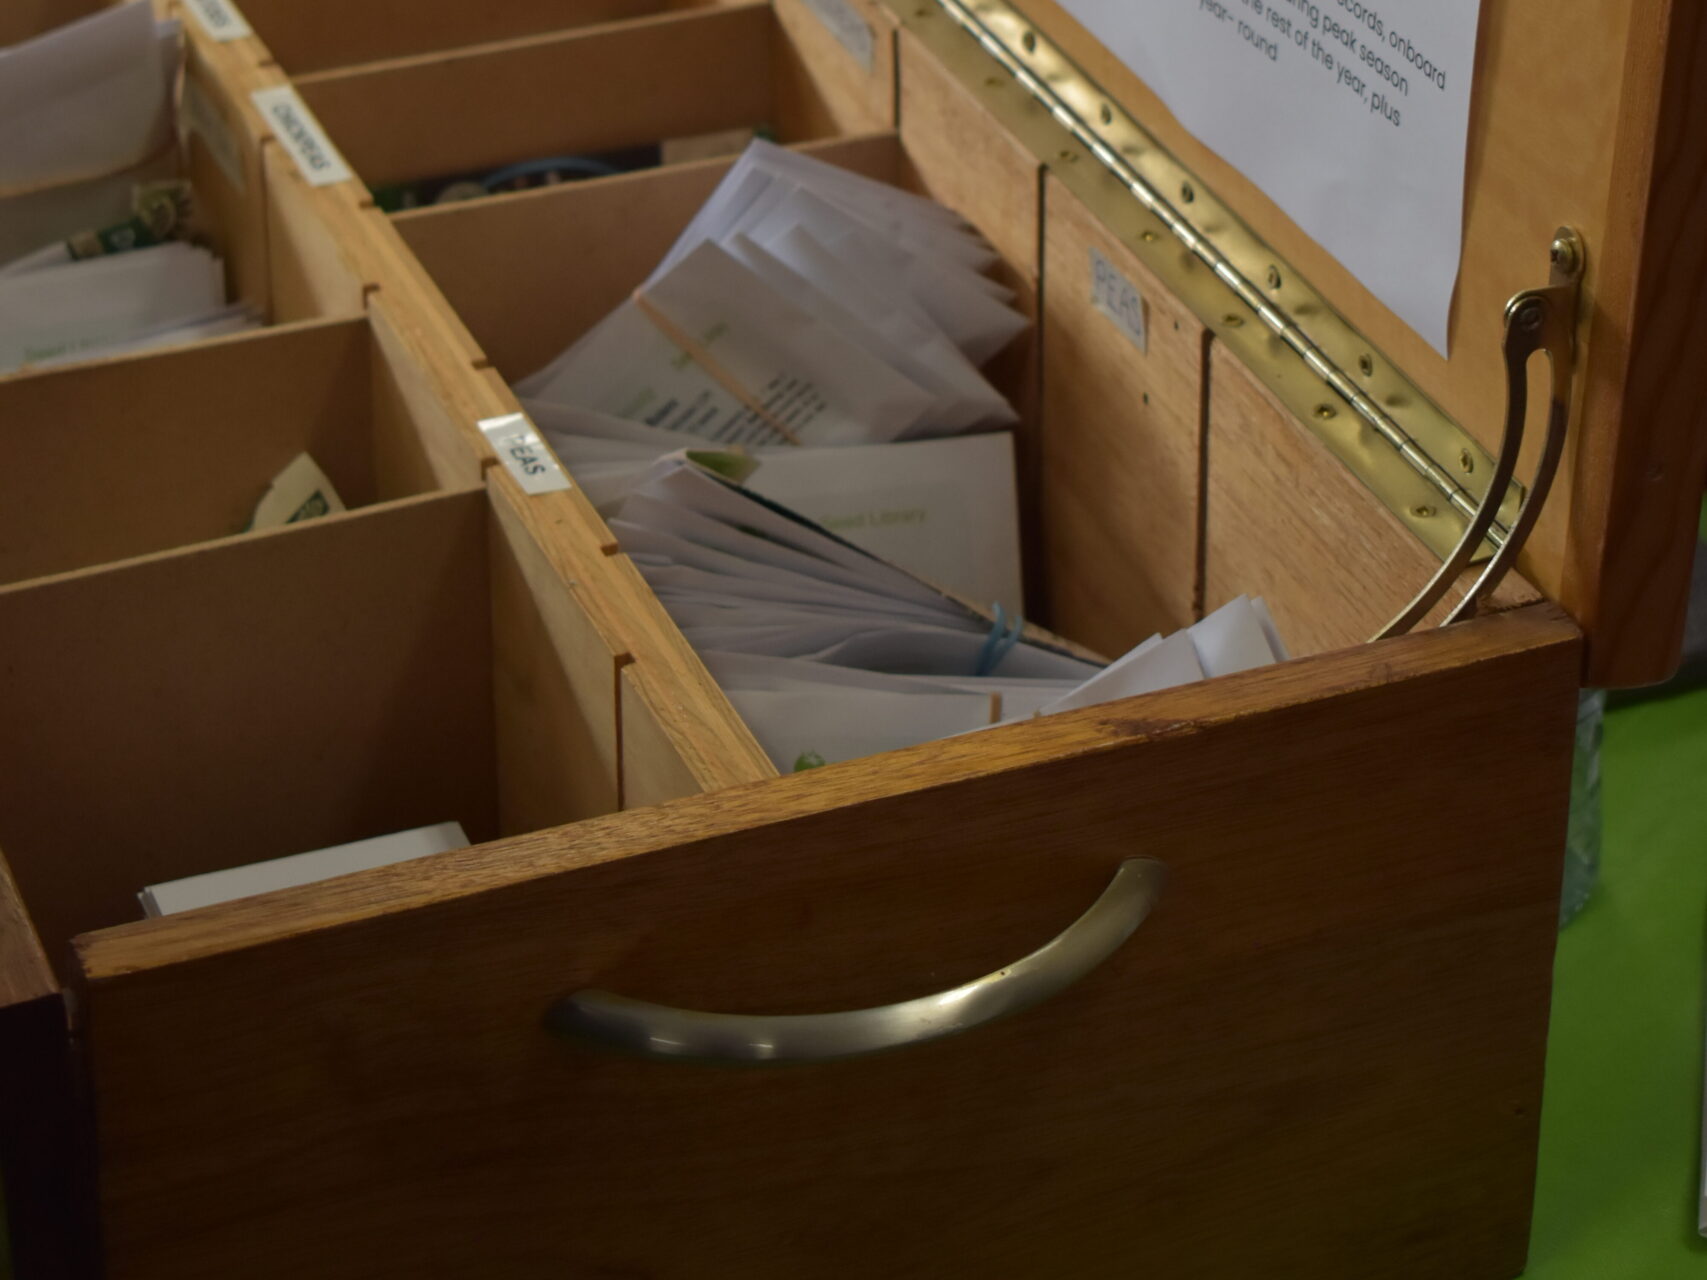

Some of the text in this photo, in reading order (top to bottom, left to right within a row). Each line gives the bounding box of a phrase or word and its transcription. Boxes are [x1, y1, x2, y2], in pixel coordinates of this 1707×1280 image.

[1236, 19, 1280, 62] round
[1265, 5, 1293, 40] rest
[1294, 29, 1310, 51] of
[1310, 38, 1335, 71] the
[1336, 61, 1369, 104] year,
[1370, 91, 1401, 128] plus
[1322, 14, 1358, 55] peak
[1359, 43, 1409, 97] season
[1388, 30, 1447, 92] onboard
[1094, 259, 1142, 338] PEAS
[509, 434, 547, 476] PEAS
